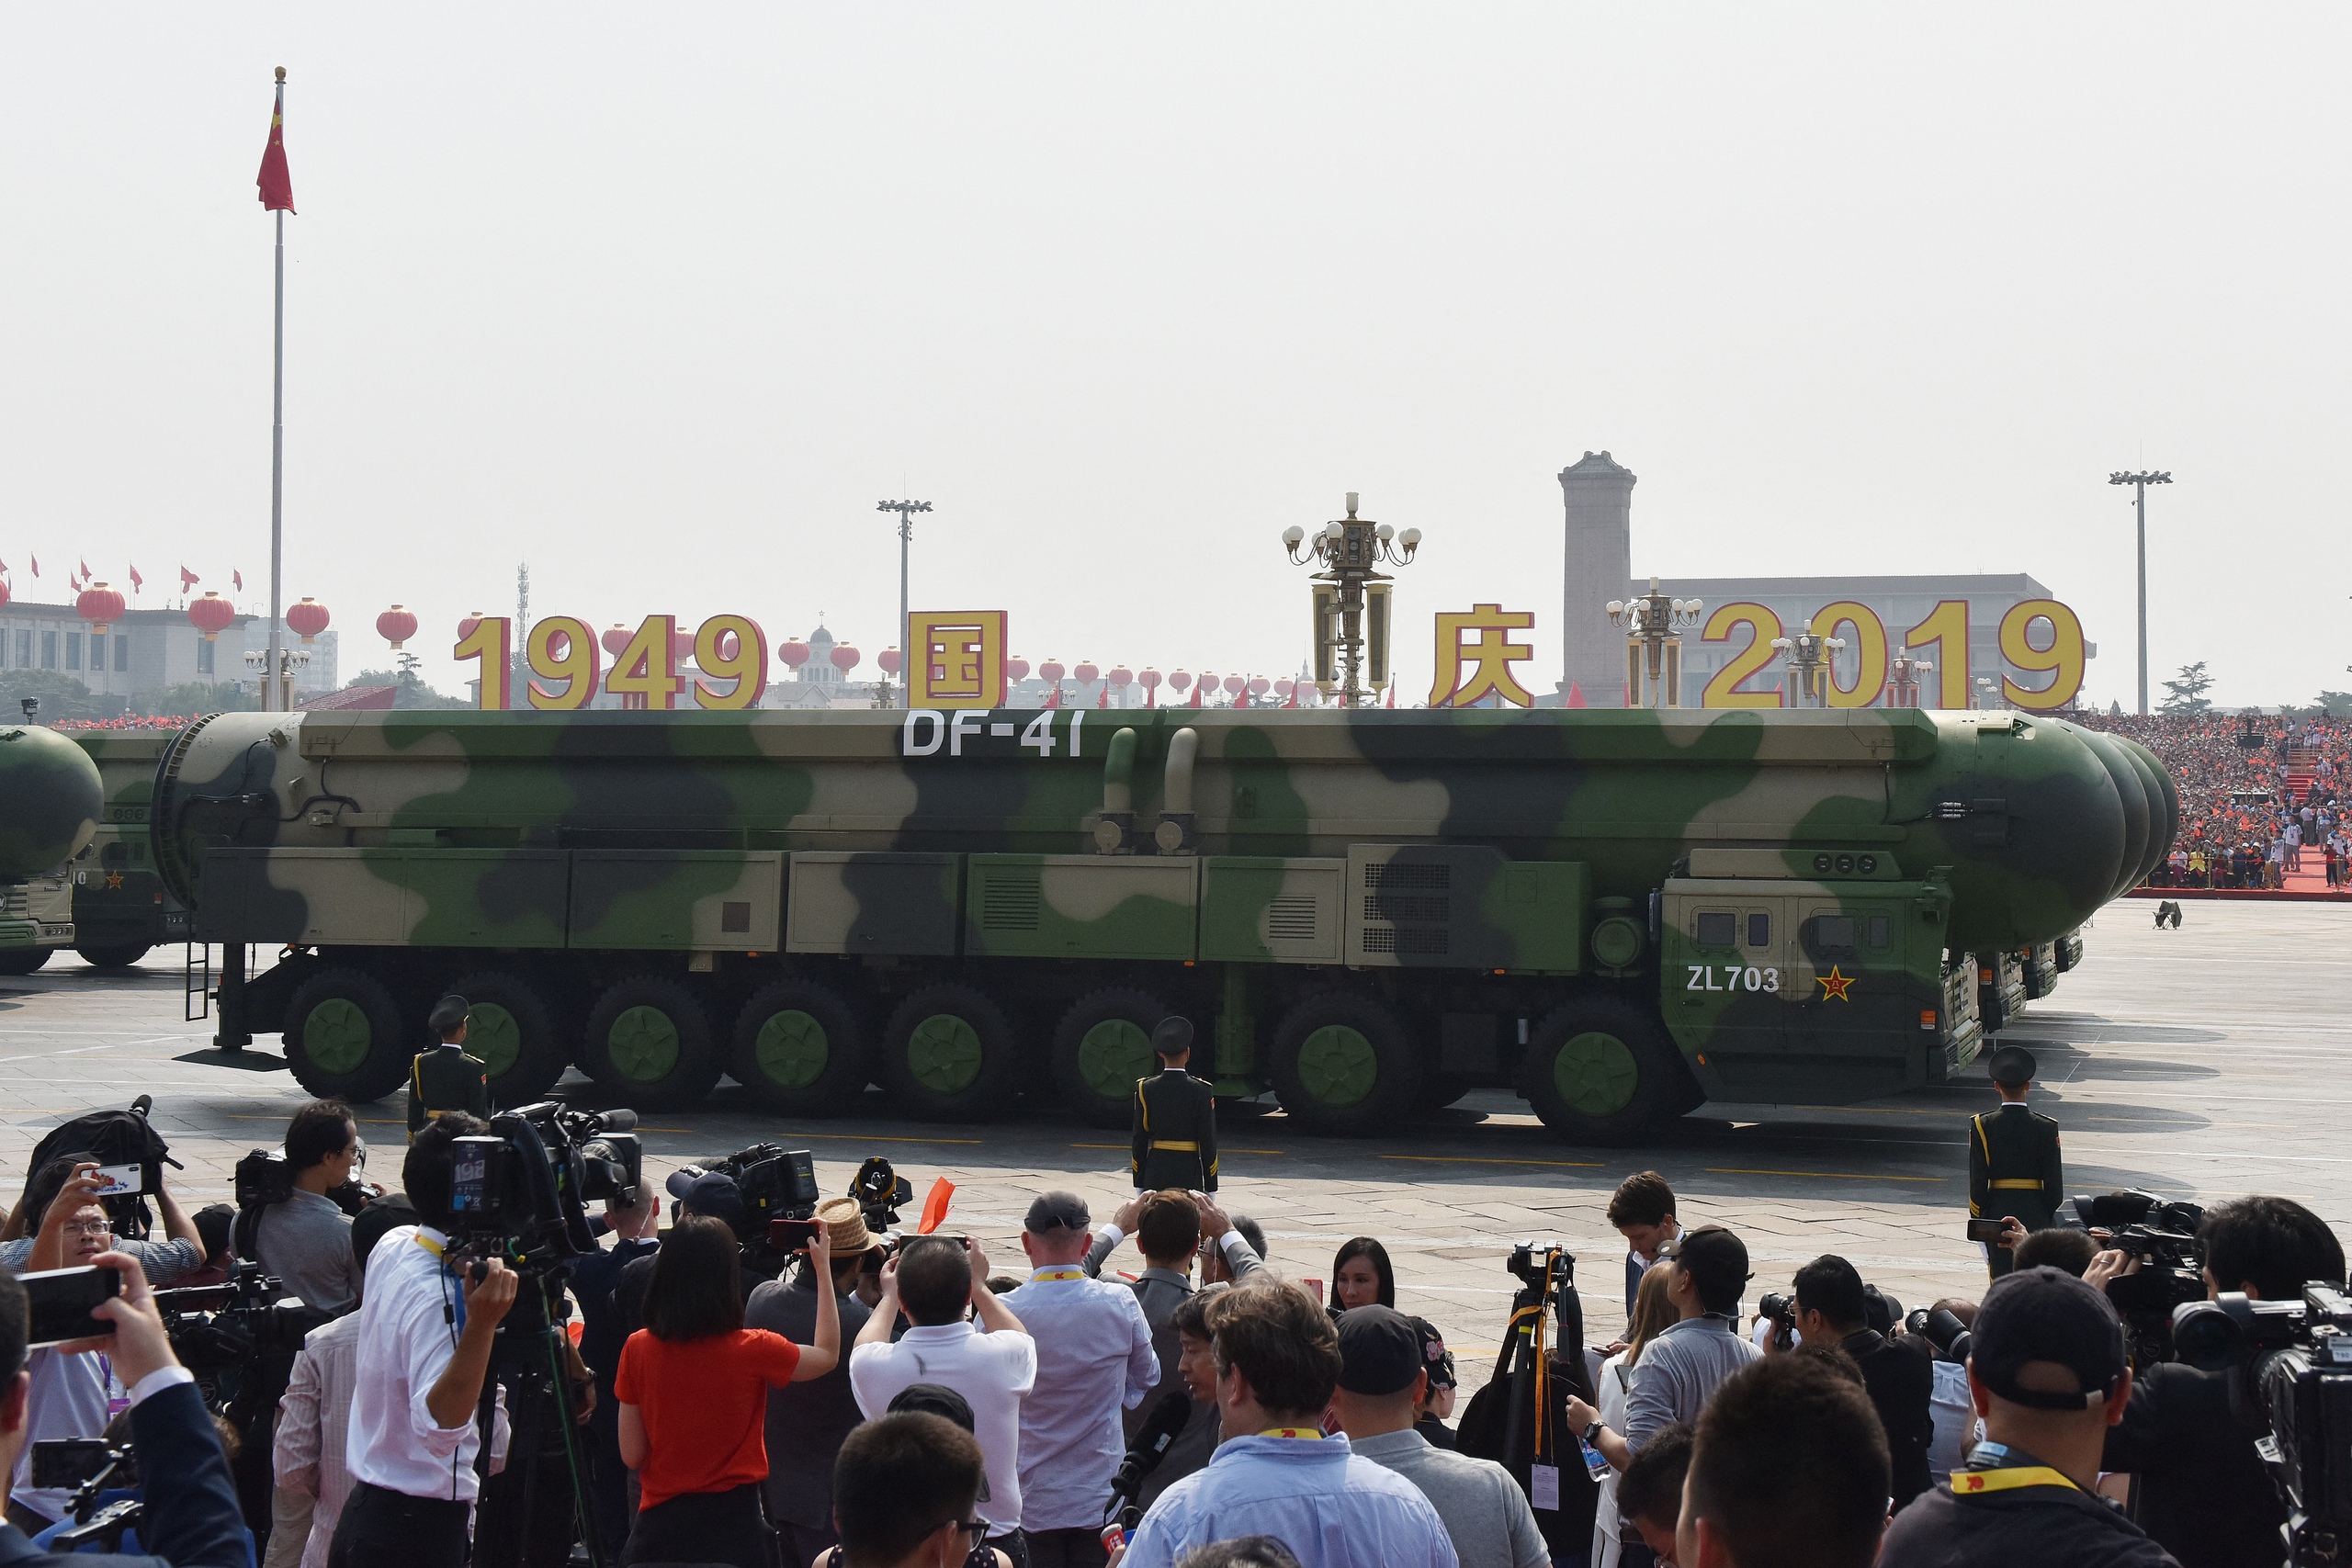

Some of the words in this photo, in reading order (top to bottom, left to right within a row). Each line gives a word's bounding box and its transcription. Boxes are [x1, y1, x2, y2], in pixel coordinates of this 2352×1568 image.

[454, 614, 769, 710] 1949
[907, 610, 1008, 709] 国
[1429, 603, 1535, 709] 庆
[1701, 598, 2086, 710] 2019
[903, 709, 1086, 757] DF-41
[1687, 965, 1780, 993] ZL703
